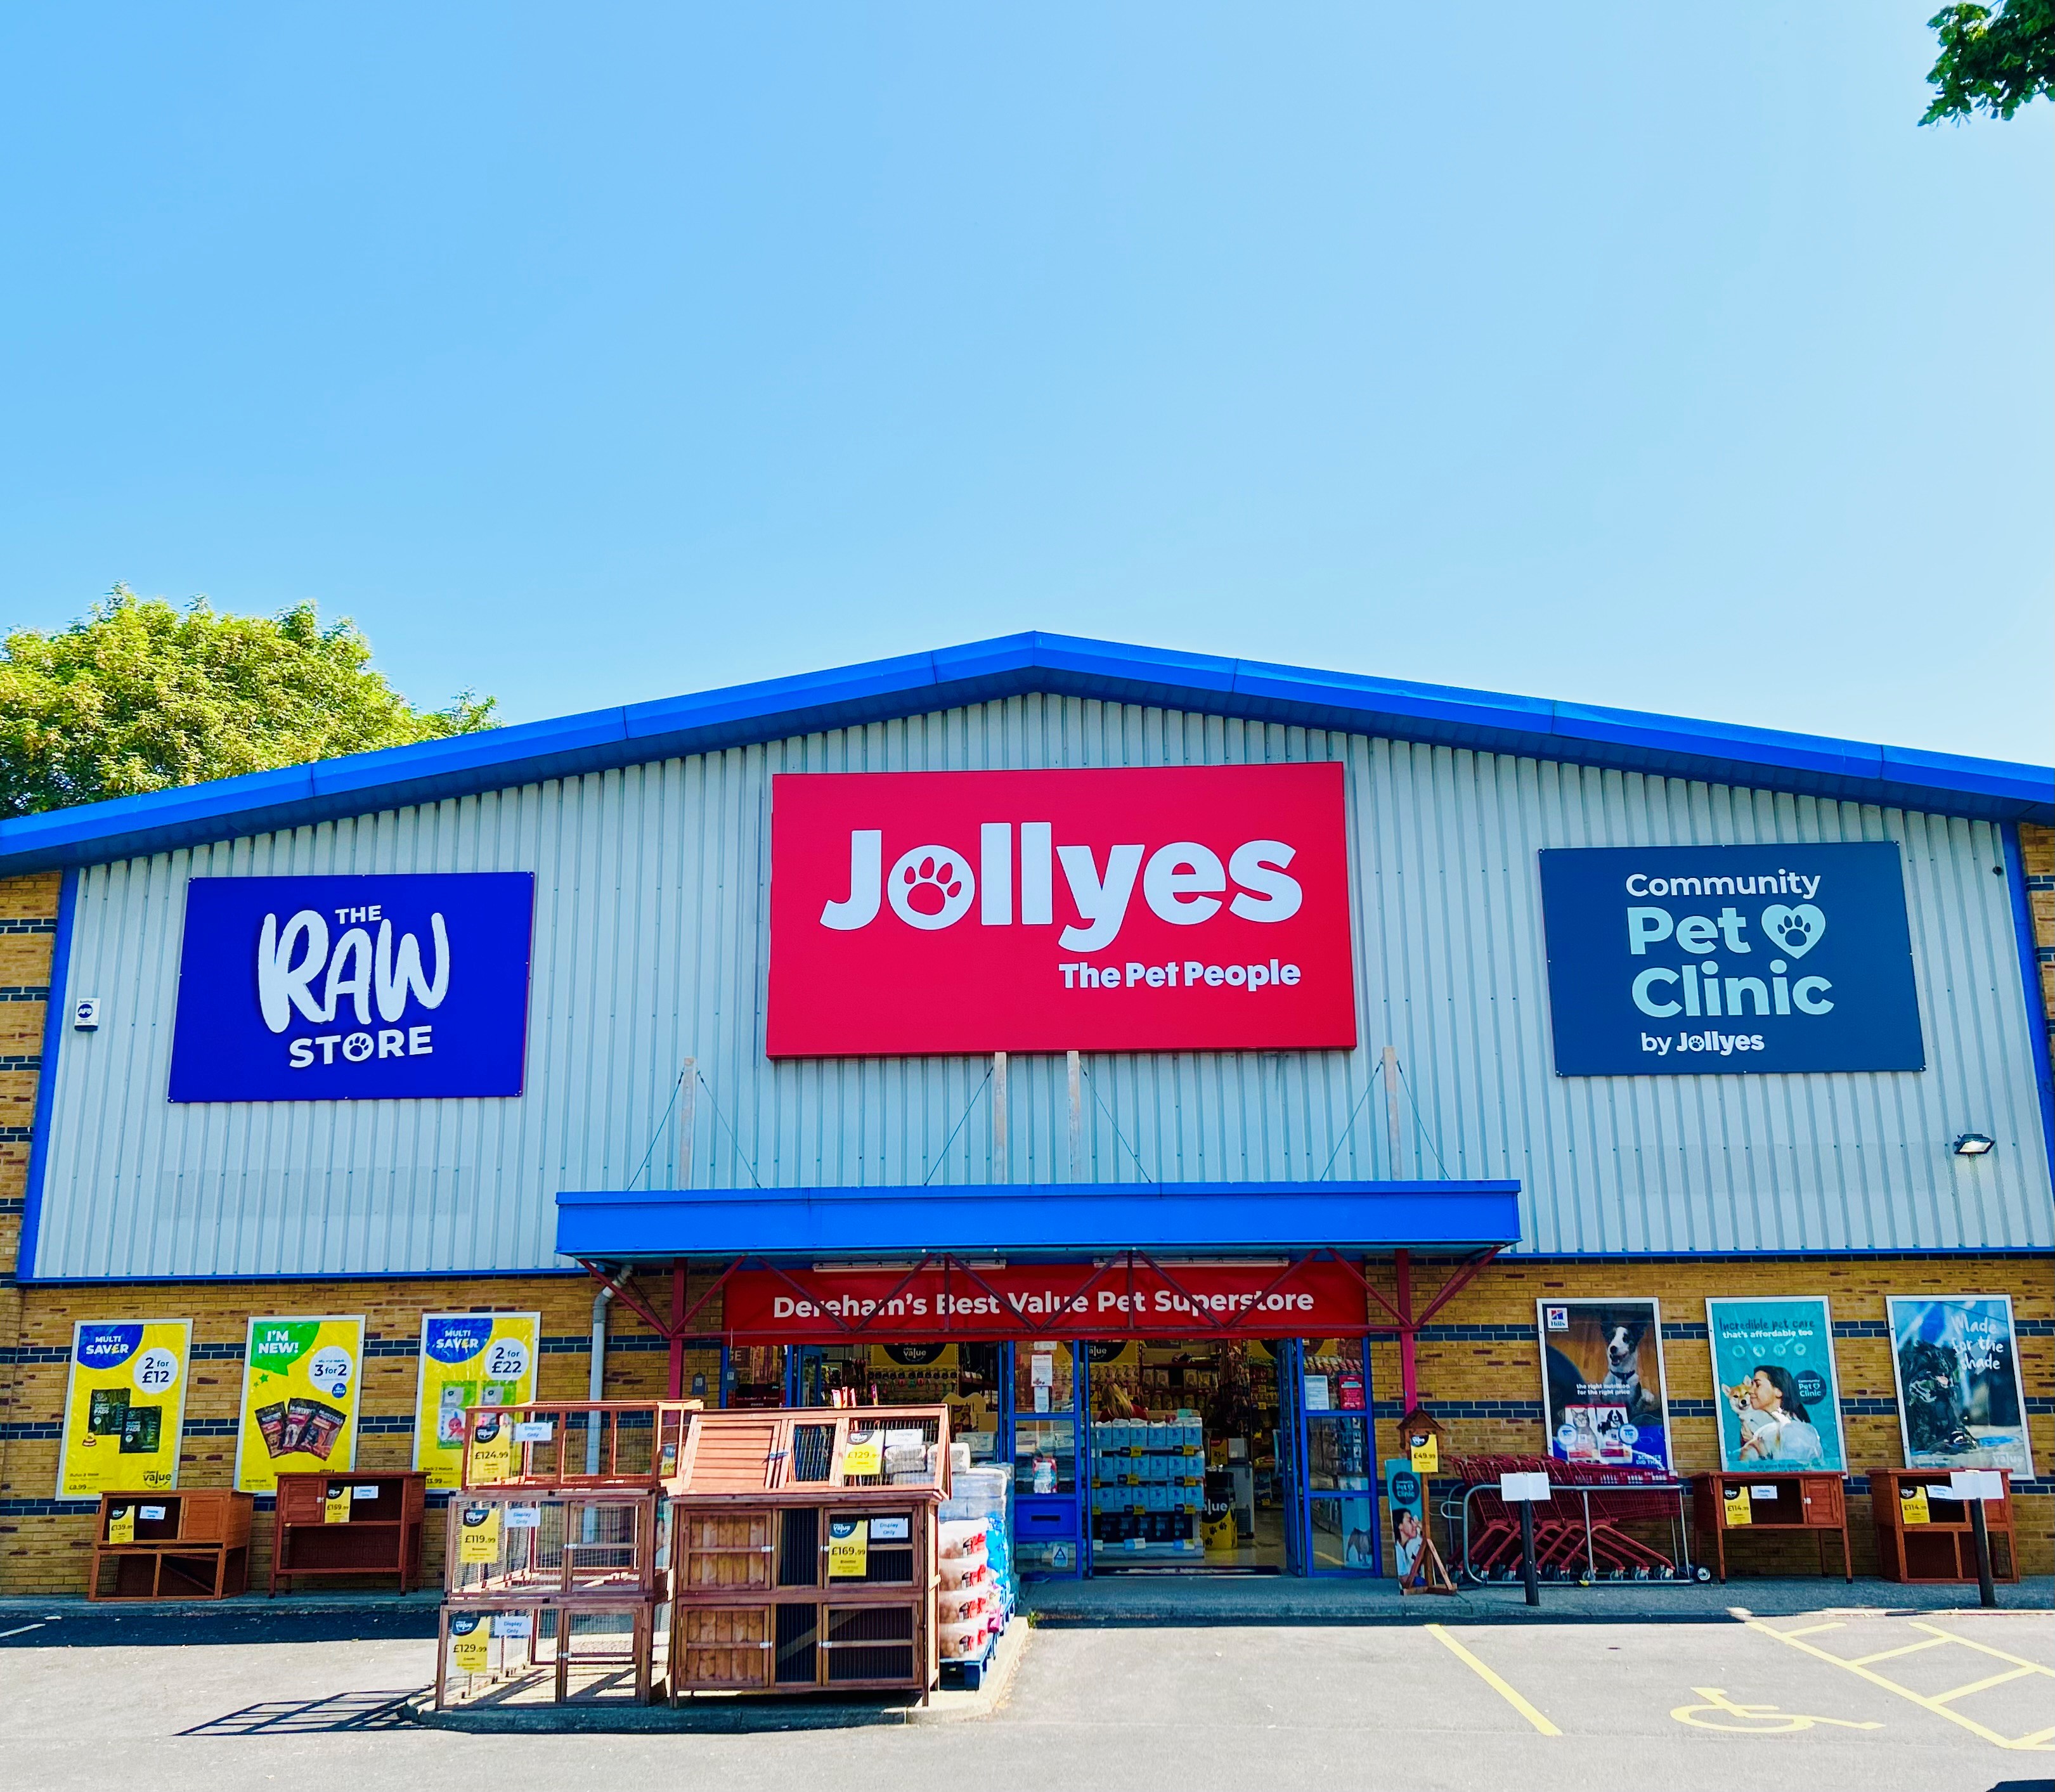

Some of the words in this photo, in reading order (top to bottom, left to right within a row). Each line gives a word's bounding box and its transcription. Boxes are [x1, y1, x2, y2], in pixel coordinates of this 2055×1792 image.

[820, 822, 1302, 952] Jollyes
[1626, 869, 1820, 899] Community
[335, 905, 382, 924] THE
[1627, 907, 1751, 955] Pet
[258, 910, 450, 1033] RAW
[1059, 962, 1120, 988] The
[1126, 962, 1179, 988] Pet
[1184, 959, 1300, 992] People
[1631, 960, 1834, 1017] Clinic
[289, 1026, 432, 1067] STORE
[1641, 1033, 1672, 1055] by
[1676, 1031, 1765, 1055] Jollyes
[774, 1293, 927, 1318] Dereham's
[937, 1294, 1001, 1315] Best
[1008, 1291, 1089, 1313] Value
[1098, 1291, 1146, 1312] Pet
[1155, 1291, 1314, 1317] Superstore
[1719, 1318, 1768, 1331] Incredible
[1772, 1318, 1789, 1331] pet
[1792, 1319, 1815, 1328] care
[1951, 1313, 1998, 1333] Made
[267, 1331, 288, 1341] I'M
[1750, 1330, 1796, 1338] affordable
[258, 1343, 299, 1354] NEW!
[1952, 1338, 1972, 1355] for
[1978, 1336, 2004, 1353] the
[495, 1347, 505, 1360] 2
[145, 1357, 154, 1369] 2
[491, 1361, 522, 1374] £22
[1960, 1353, 2000, 1369] shade
[142, 1370, 169, 1383] £12
[314, 1364, 323, 1376] 3
[338, 1364, 347, 1376] 2
[475, 1451, 509, 1459] £124.99
[143, 1471, 172, 1484] value
[465, 1535, 496, 1544] £119.99
[832, 1547, 865, 1556] £169.99
[453, 1644, 487, 1653] £129.99
